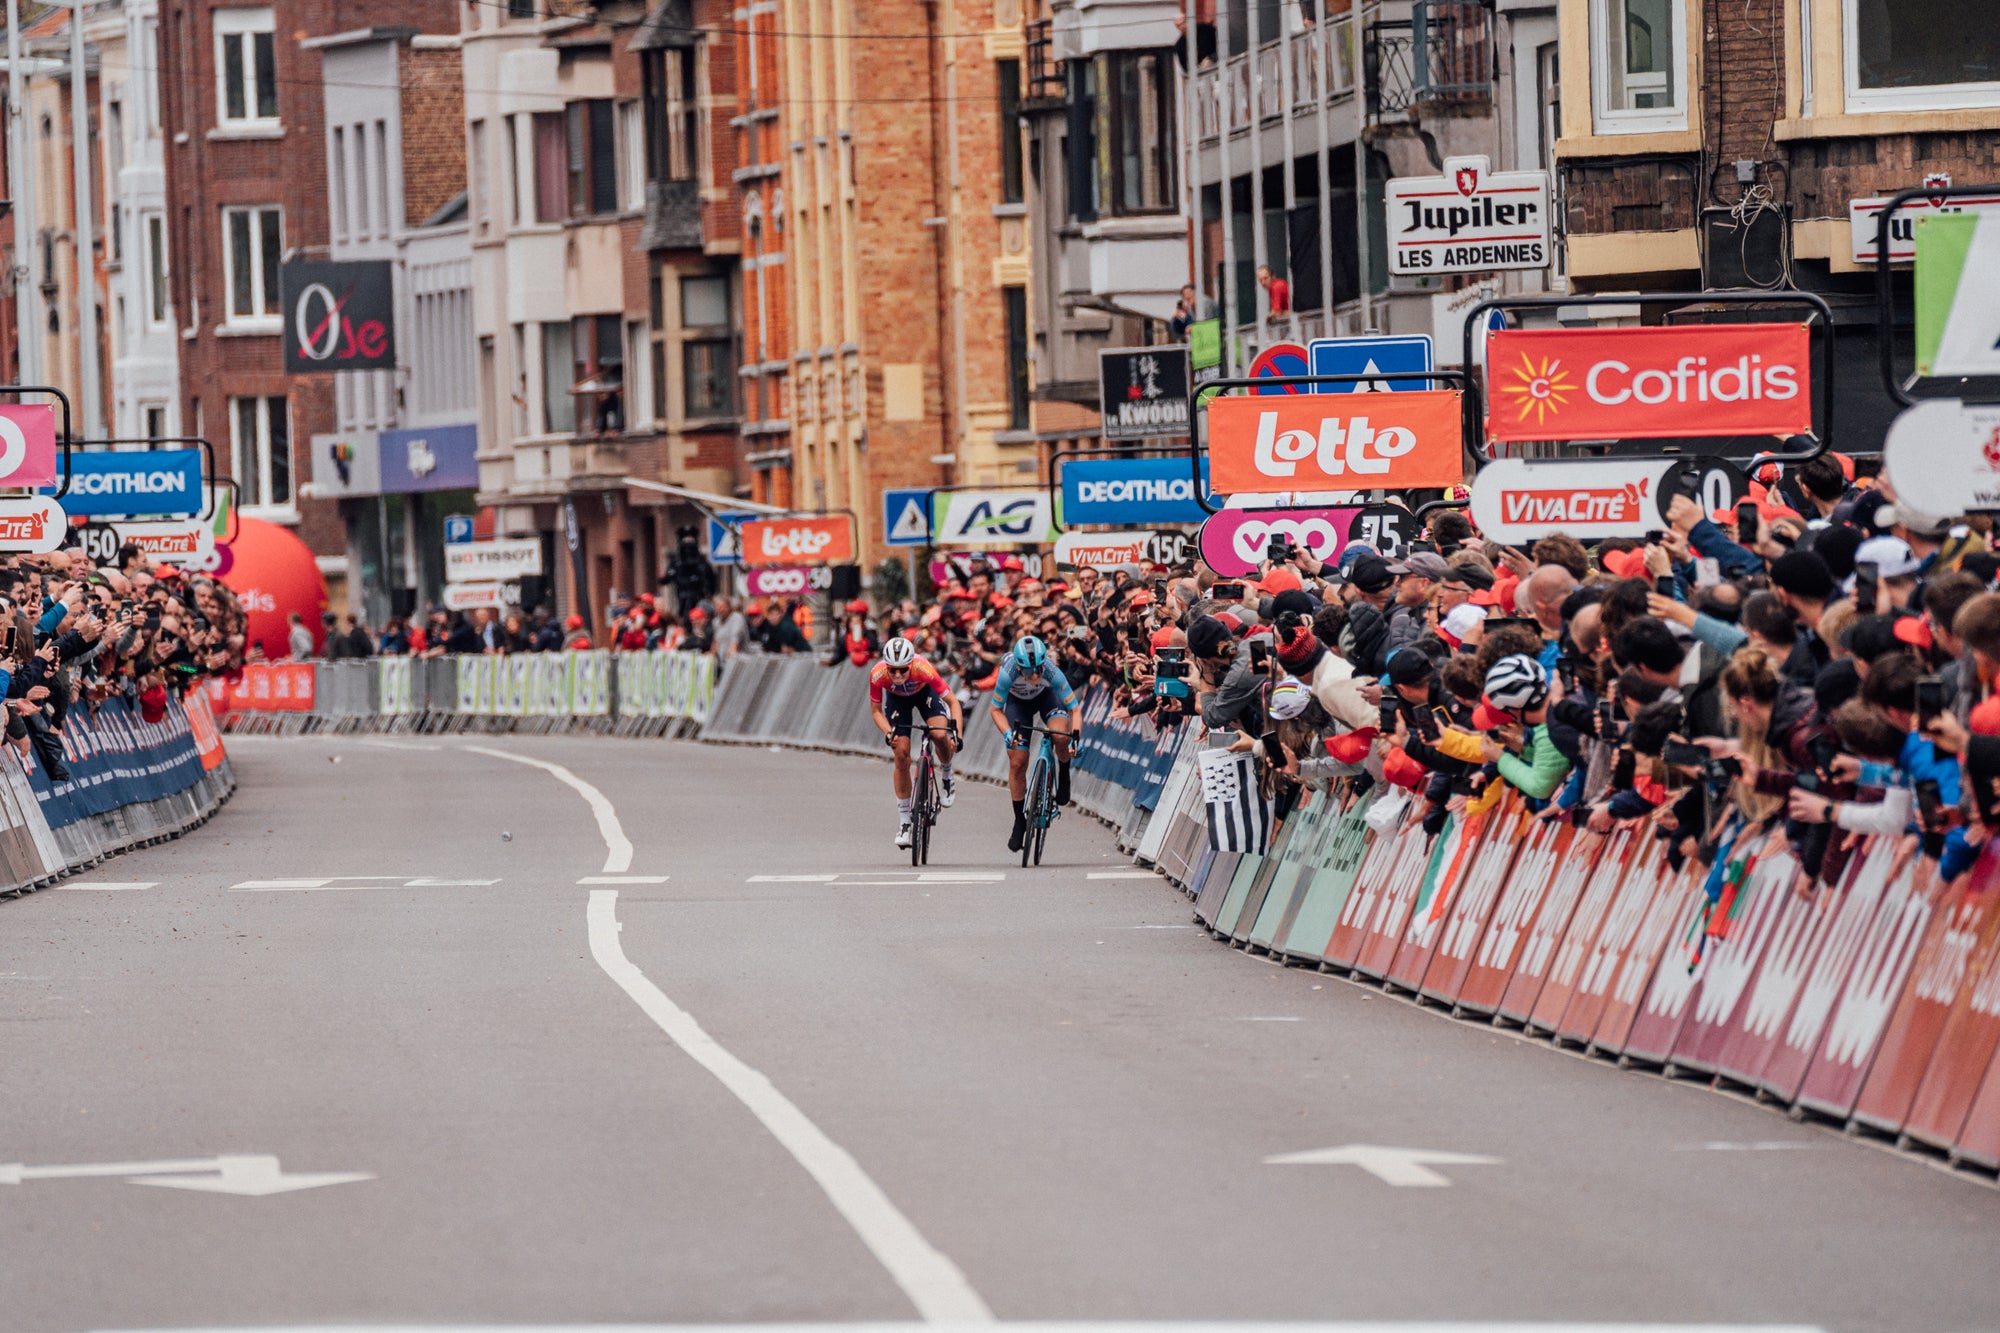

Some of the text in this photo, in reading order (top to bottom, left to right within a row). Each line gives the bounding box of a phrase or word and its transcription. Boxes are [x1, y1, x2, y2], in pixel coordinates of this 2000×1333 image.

[1401, 197, 1538, 237] Jupiler
[1399, 243, 1543, 269] LES ARDENNES
[1586, 354, 1799, 405] Cofidis
[1254, 411, 1417, 477] lotto
[56, 471, 185, 495] DECATHLON
[1078, 479, 1207, 503] DECATHLON
[451, 520, 468, 542] P
[958, 500, 1037, 536] AG
[77, 528, 119, 561] 150
[761, 526, 832, 556] lotto
[1151, 535, 1189, 565] 150
[1361, 514, 1402, 558] 75
[477, 548, 534, 563] TISSOT
